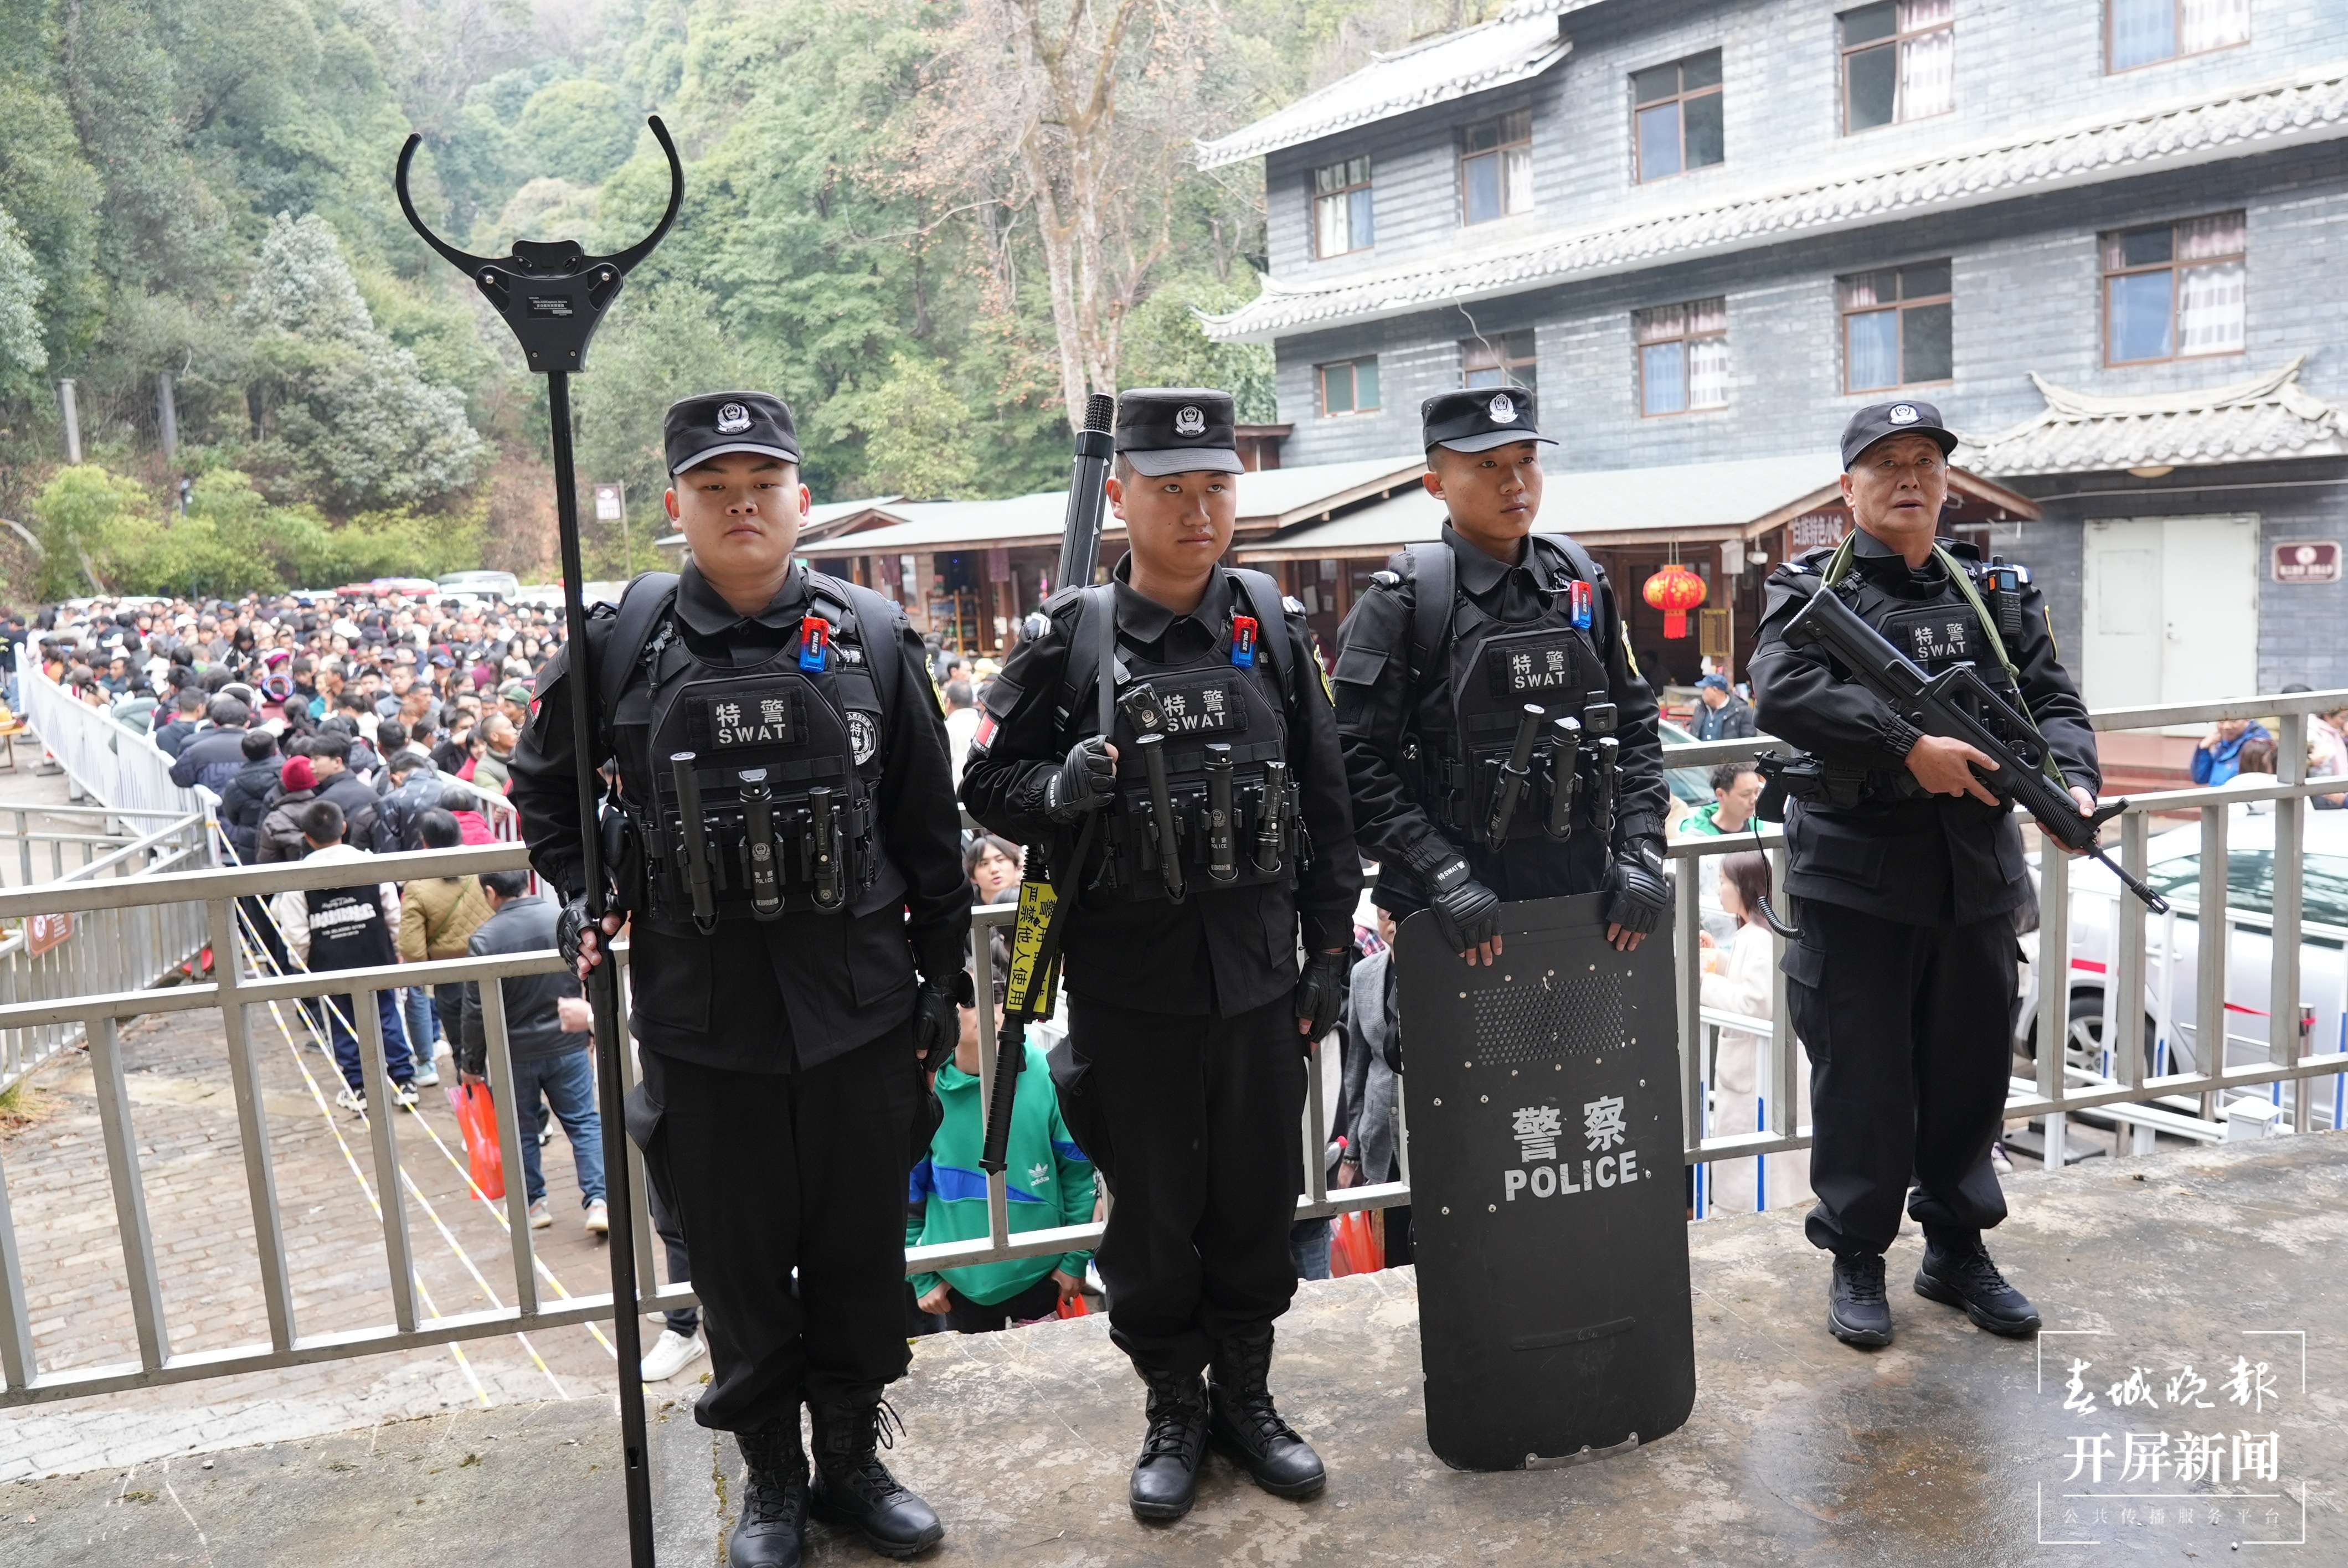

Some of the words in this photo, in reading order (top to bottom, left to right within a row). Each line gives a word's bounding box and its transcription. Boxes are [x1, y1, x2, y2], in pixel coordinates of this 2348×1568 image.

[1915, 622, 1964, 646] 特警
[1513, 650, 1564, 675] 特警
[1918, 641, 1966, 659] SWAT
[1515, 671, 1566, 689] SWAT
[716, 699, 785, 727] 特警
[1163, 689, 1224, 717] 特警
[718, 723, 786, 744] SWAT
[1166, 711, 1225, 733] SWAT
[1009, 884, 1039, 1006] 严禁他人使用
[1512, 1095, 1627, 1163] 警察
[1504, 1150, 1638, 1201] POLICE
